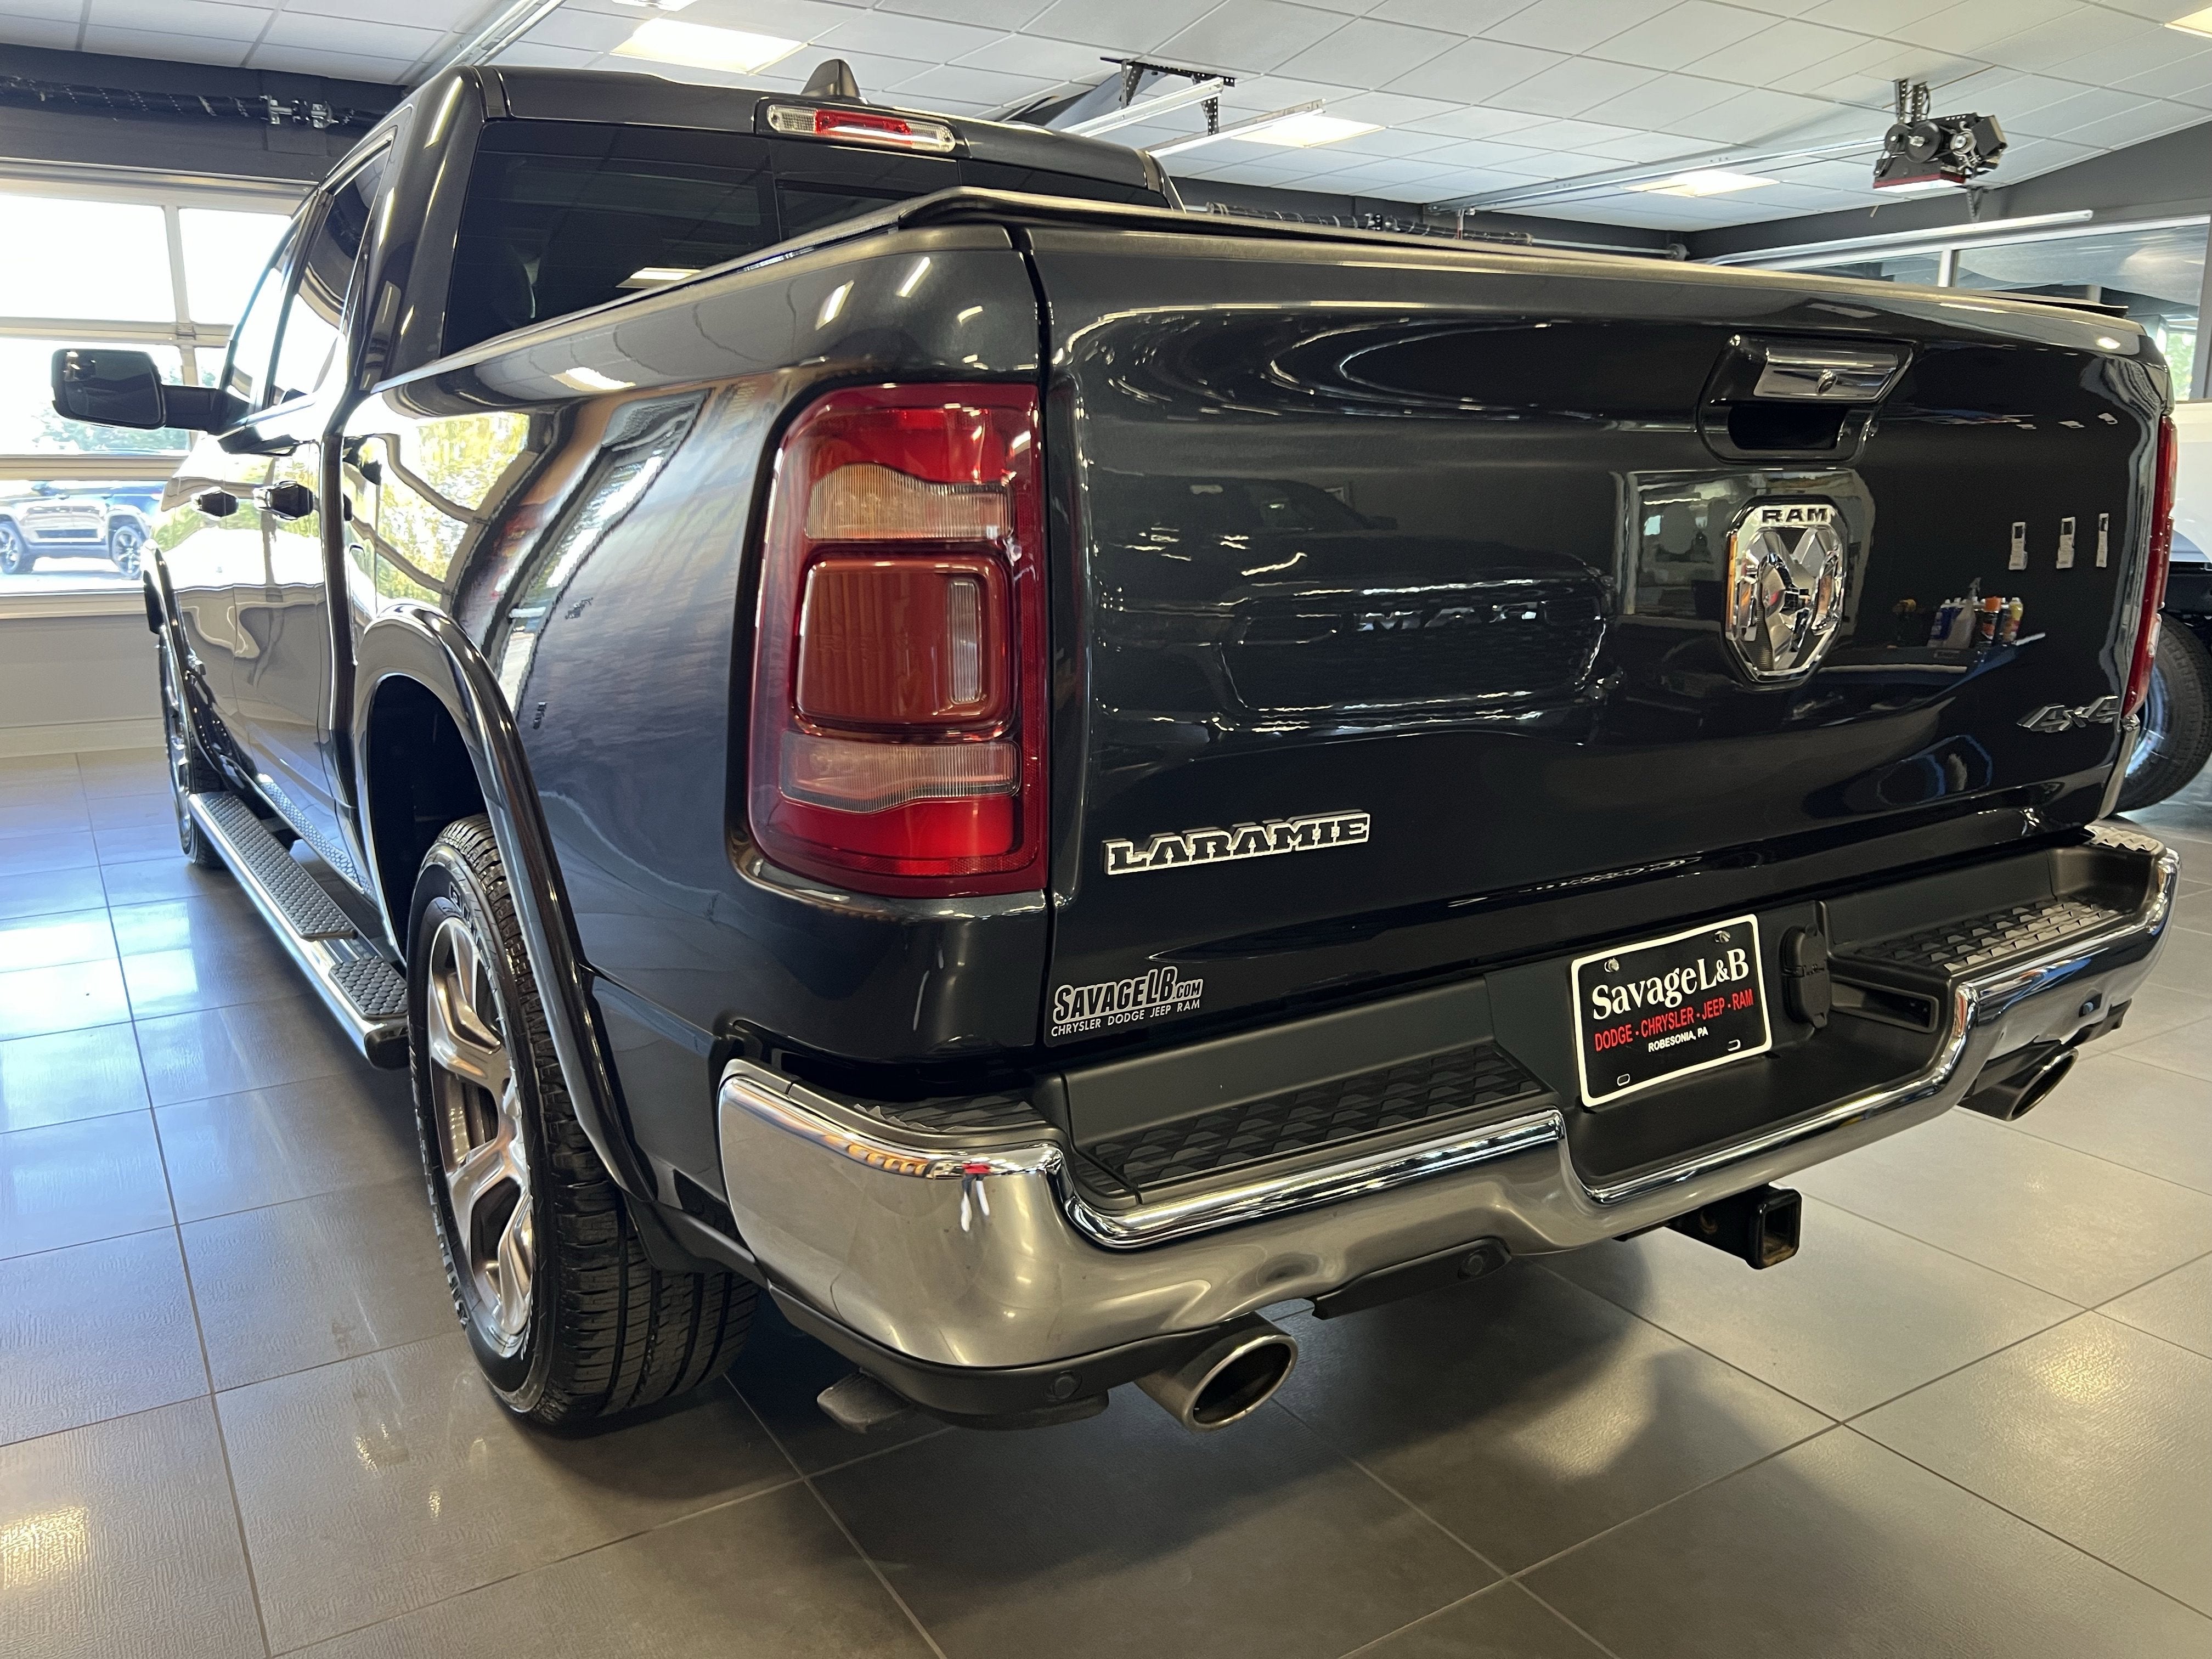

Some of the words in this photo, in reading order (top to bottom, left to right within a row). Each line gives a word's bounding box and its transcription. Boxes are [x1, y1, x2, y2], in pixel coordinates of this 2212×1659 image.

[1762, 507, 1828, 523] RAM
[1103, 810, 1370, 875] LARAMIE
[1051, 1018, 1101, 1037] CHRYSLER
[1108, 1010, 1145, 1026] DODGE
[1150, 1005, 1171, 1018] JEEP
[1177, 999, 1200, 1012] RAM
[1595, 1023, 1633, 1052] DODGE
[1641, 1007, 1695, 1037] CHRYSLER
[1702, 997, 1725, 1020] JEEP
[1732, 988, 1754, 1010] RAM
[1648, 1031, 1696, 1052] ROBESONIA,
[1697, 1026, 1708, 1037] PA
